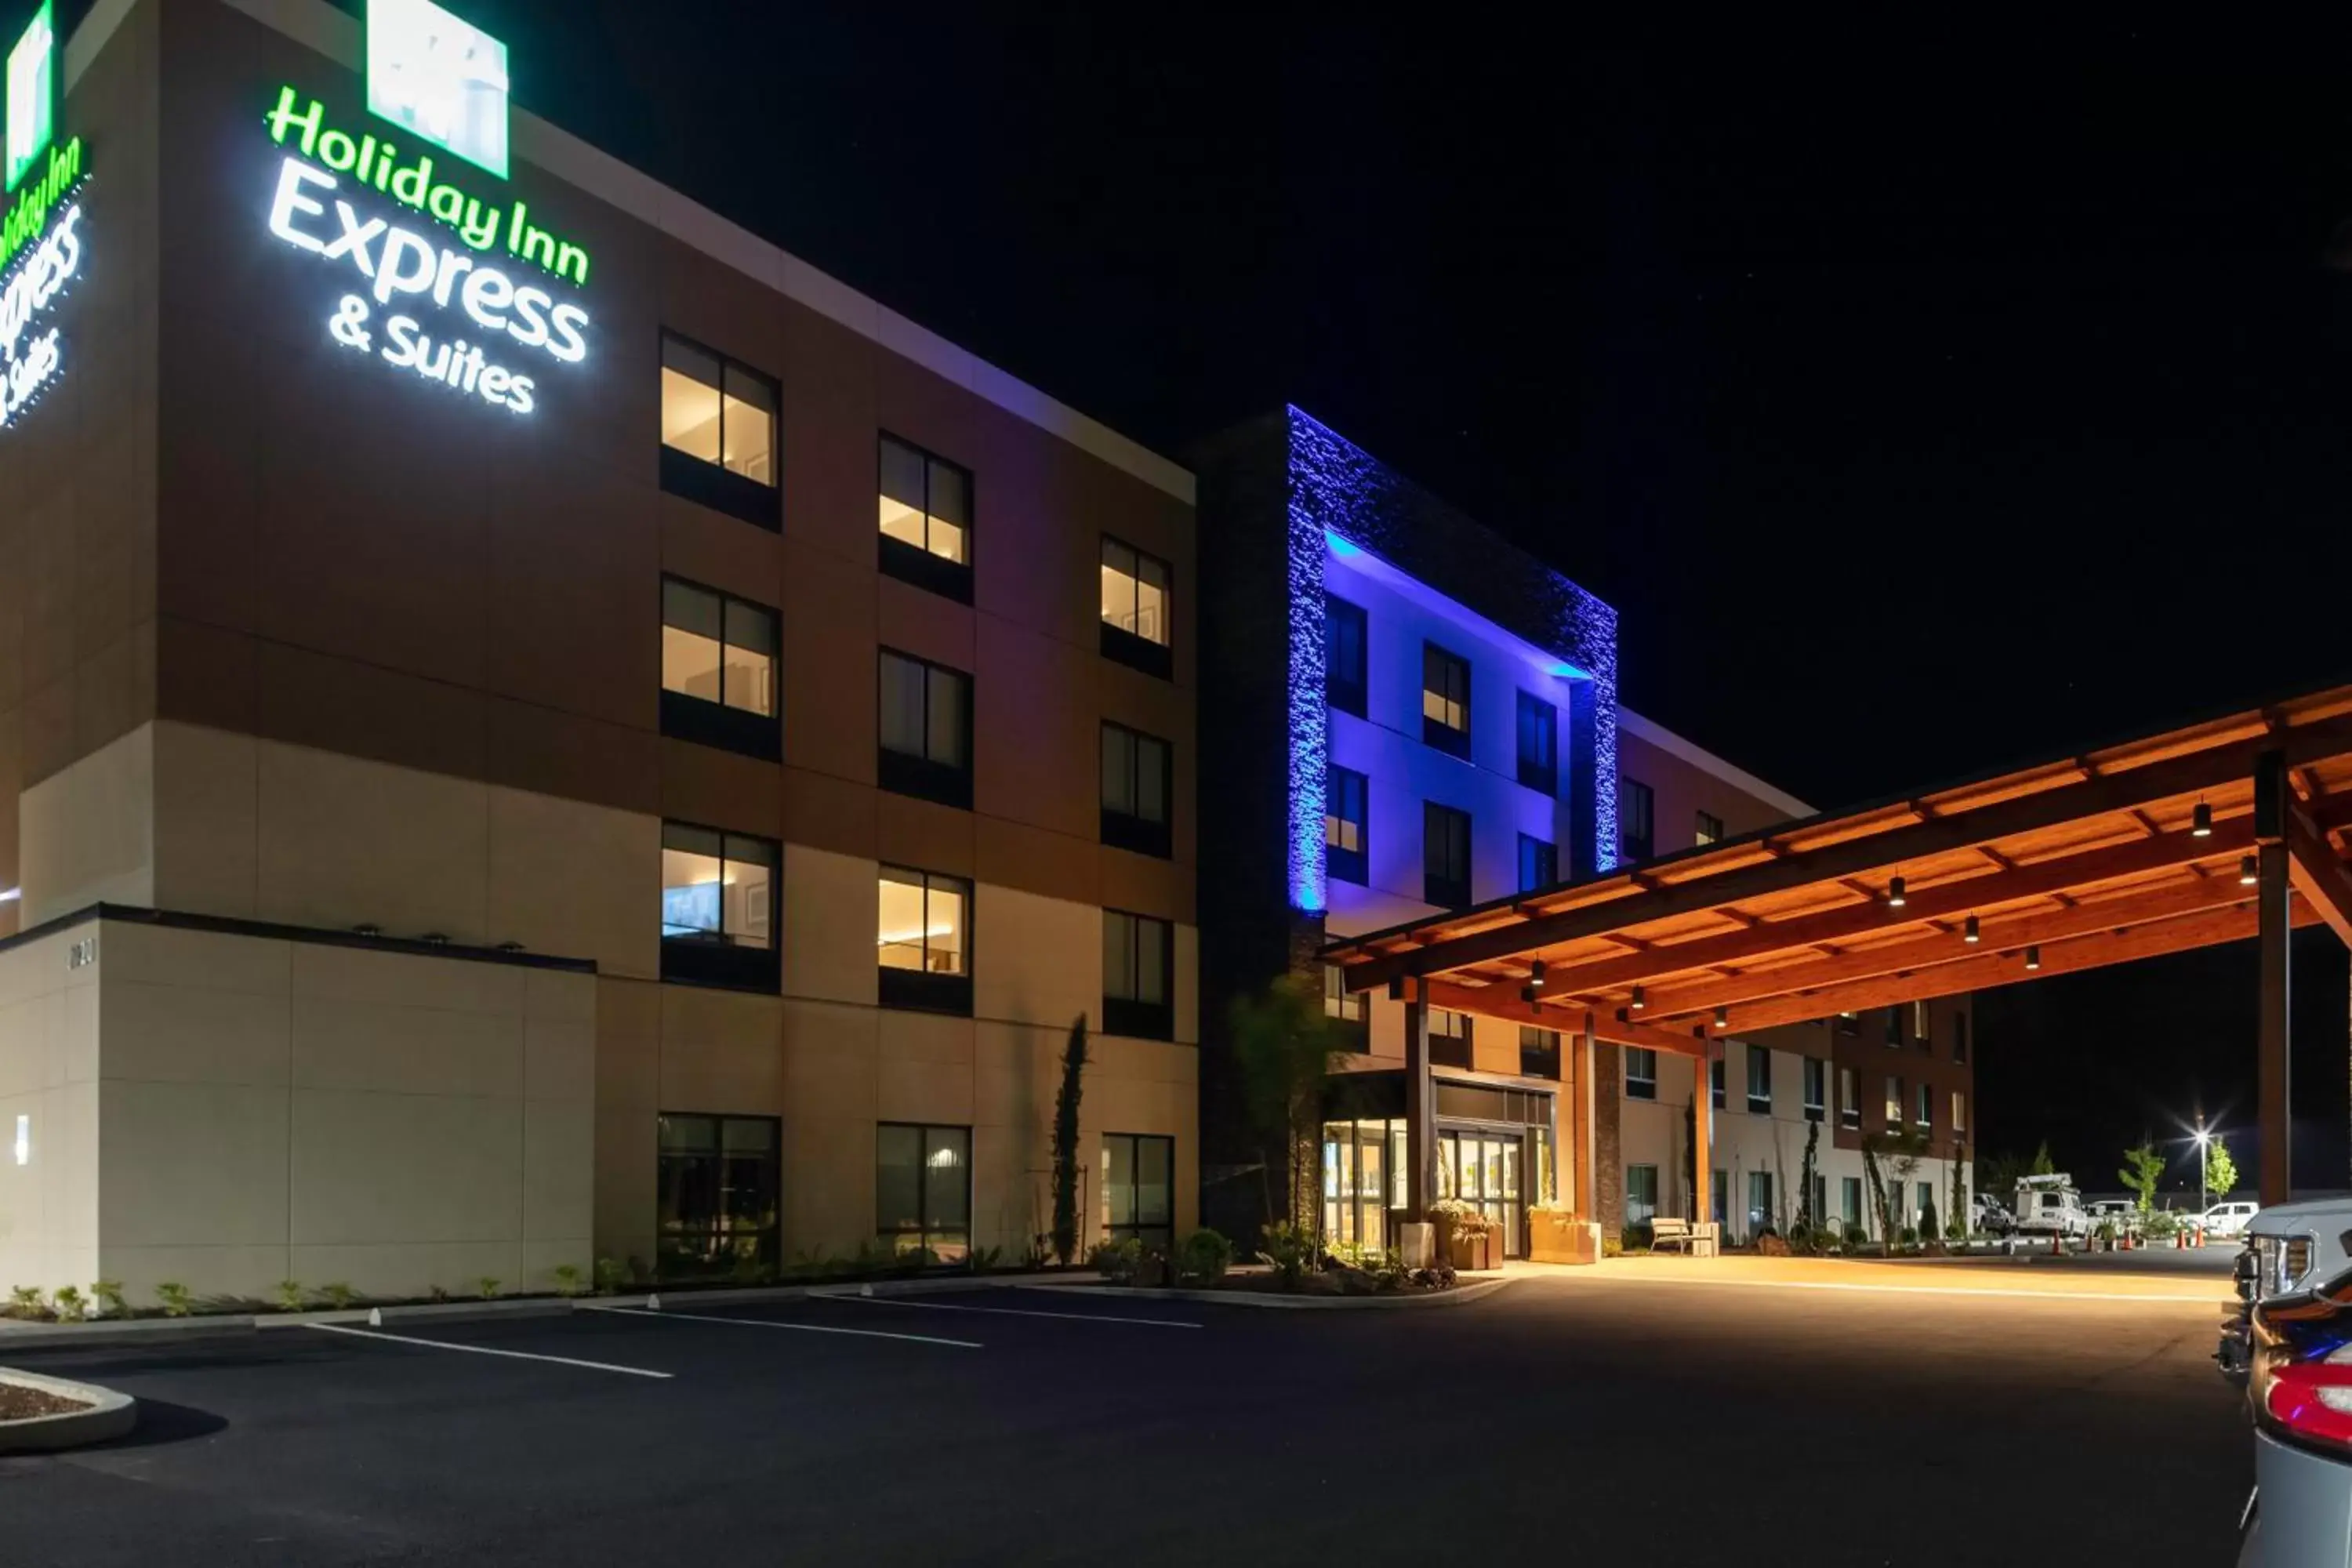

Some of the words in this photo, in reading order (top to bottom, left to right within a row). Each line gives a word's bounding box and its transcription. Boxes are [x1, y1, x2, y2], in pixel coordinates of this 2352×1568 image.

[48, 136, 80, 206] Inn
[267, 85, 500, 251] Holiday
[508, 201, 589, 285] Inn
[269, 157, 589, 363] Express
[329, 294, 372, 353] &
[381, 315, 535, 414] Suites
